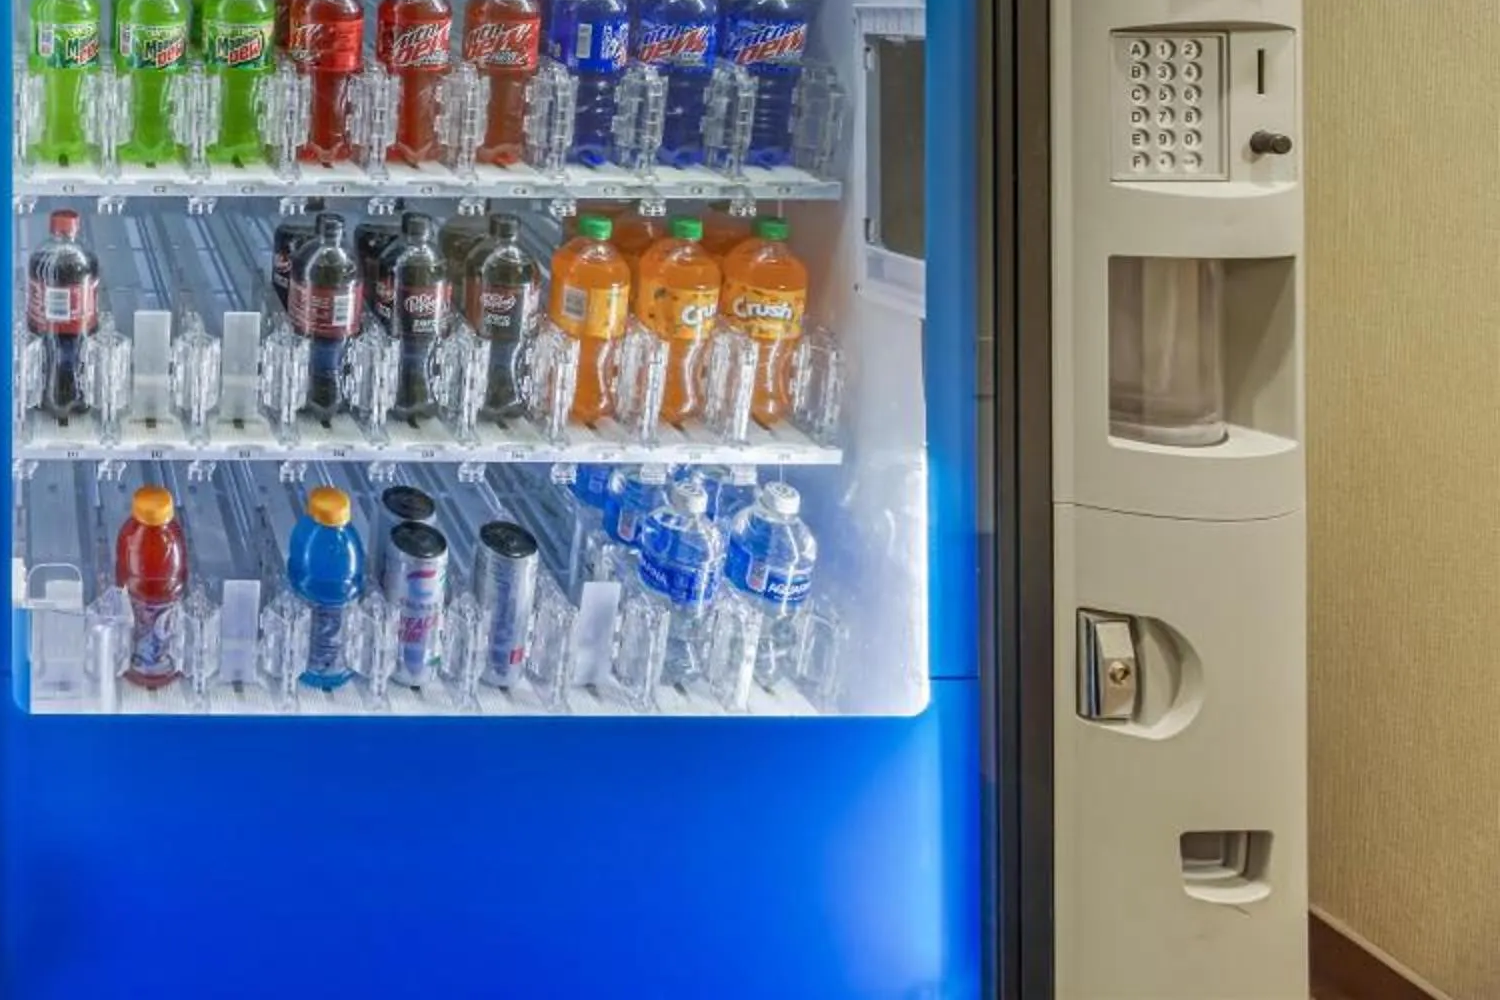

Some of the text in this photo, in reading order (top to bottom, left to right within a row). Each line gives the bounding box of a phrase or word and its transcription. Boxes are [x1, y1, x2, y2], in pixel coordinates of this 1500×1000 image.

[1131, 43, 1142, 55] A
[1132, 66, 1141, 78] B
[1131, 89, 1141, 100] C
[1132, 112, 1141, 122] D
[1132, 134, 1141, 145] E
[1133, 156, 1141, 167] F
[732, 295, 794, 320] Crush
[681, 305, 718, 325] Cru
